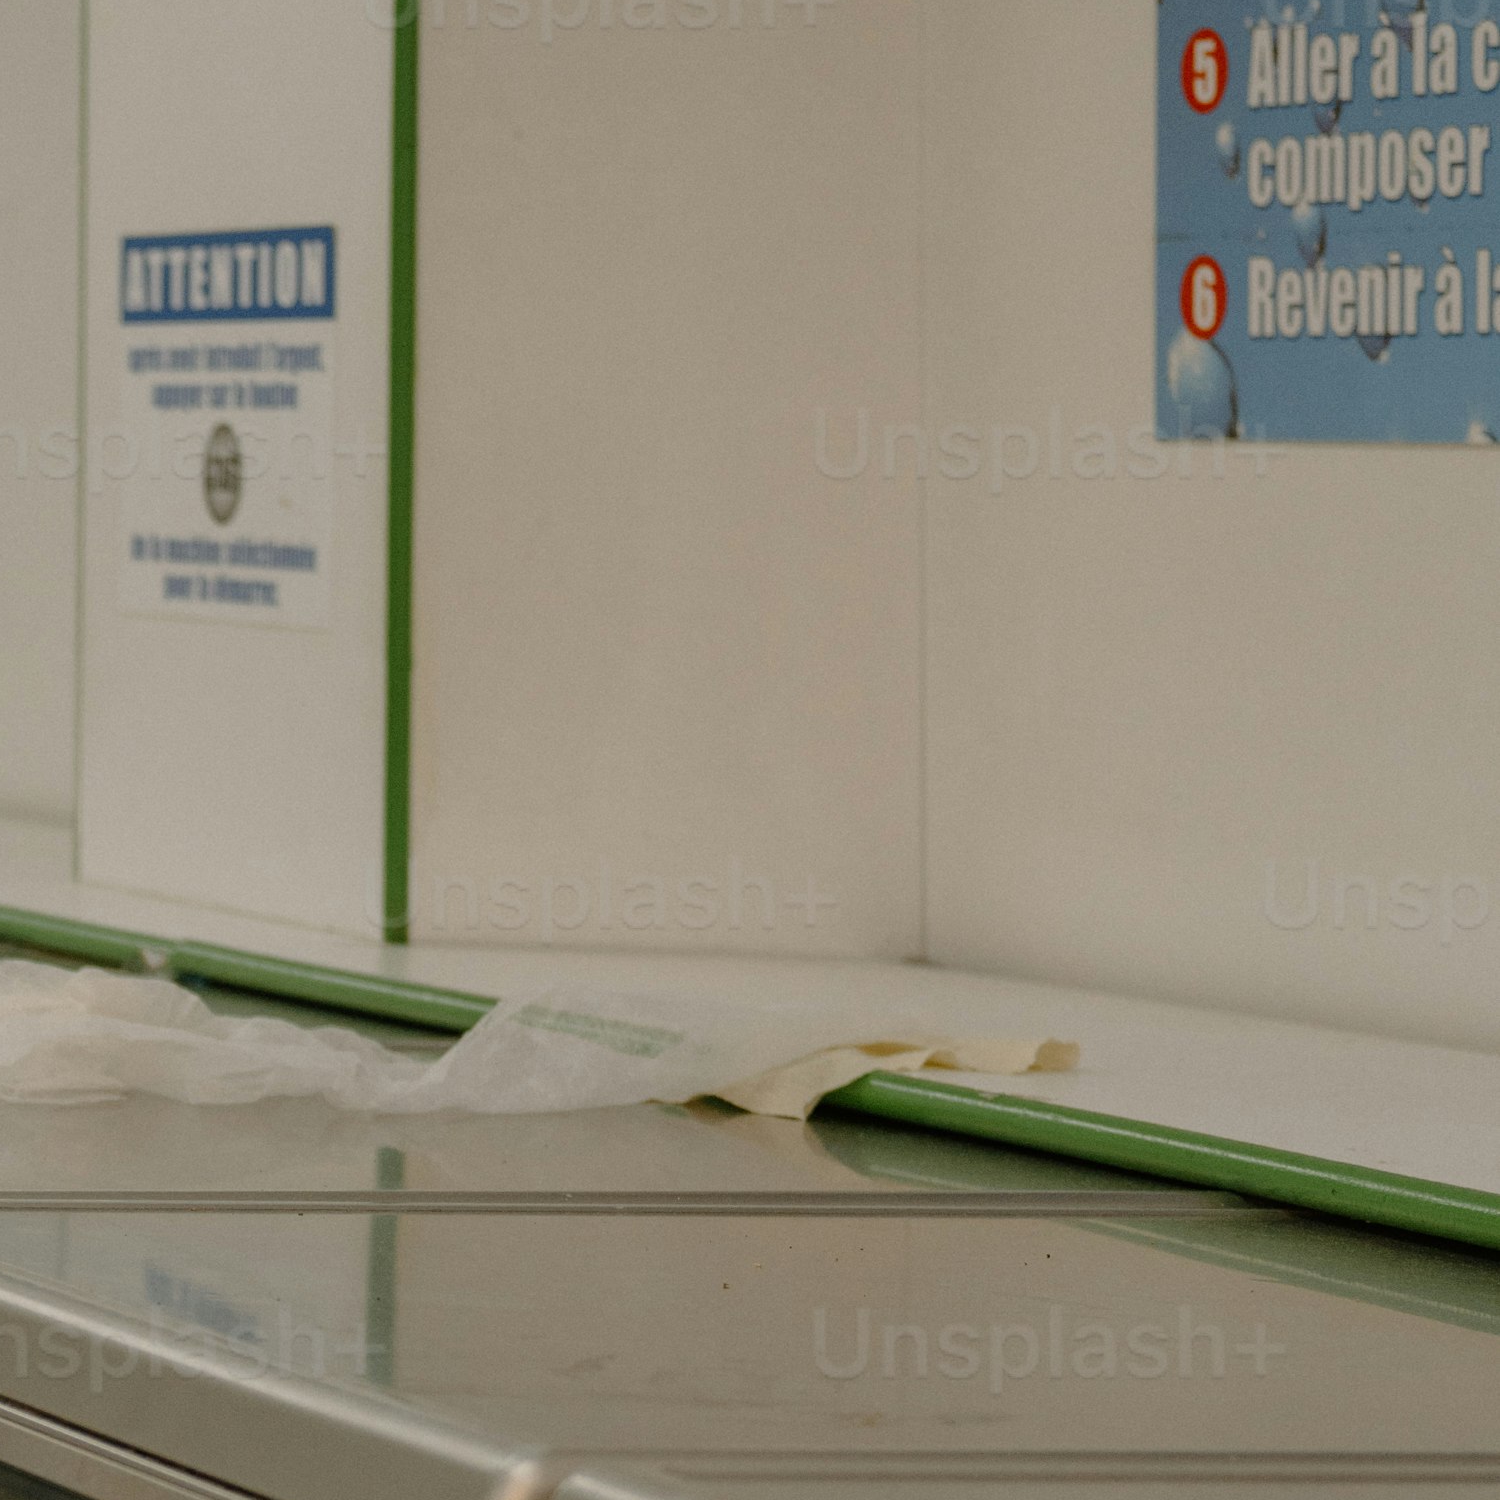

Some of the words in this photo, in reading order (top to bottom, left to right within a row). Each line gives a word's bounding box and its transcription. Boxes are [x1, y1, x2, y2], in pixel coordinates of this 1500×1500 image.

[1192, 41, 1217, 104] 5
[1248, 19, 1360, 108] Aller
[1370, 10, 1399, 99] à
[1412, 11, 1457, 96] la
[1249, 124, 1490, 211] composer
[125, 238, 327, 313] ATTENTION
[1192, 267, 1216, 330] 6
[1248, 251, 1424, 340] Revenir
[1434, 247, 1464, 336] à
